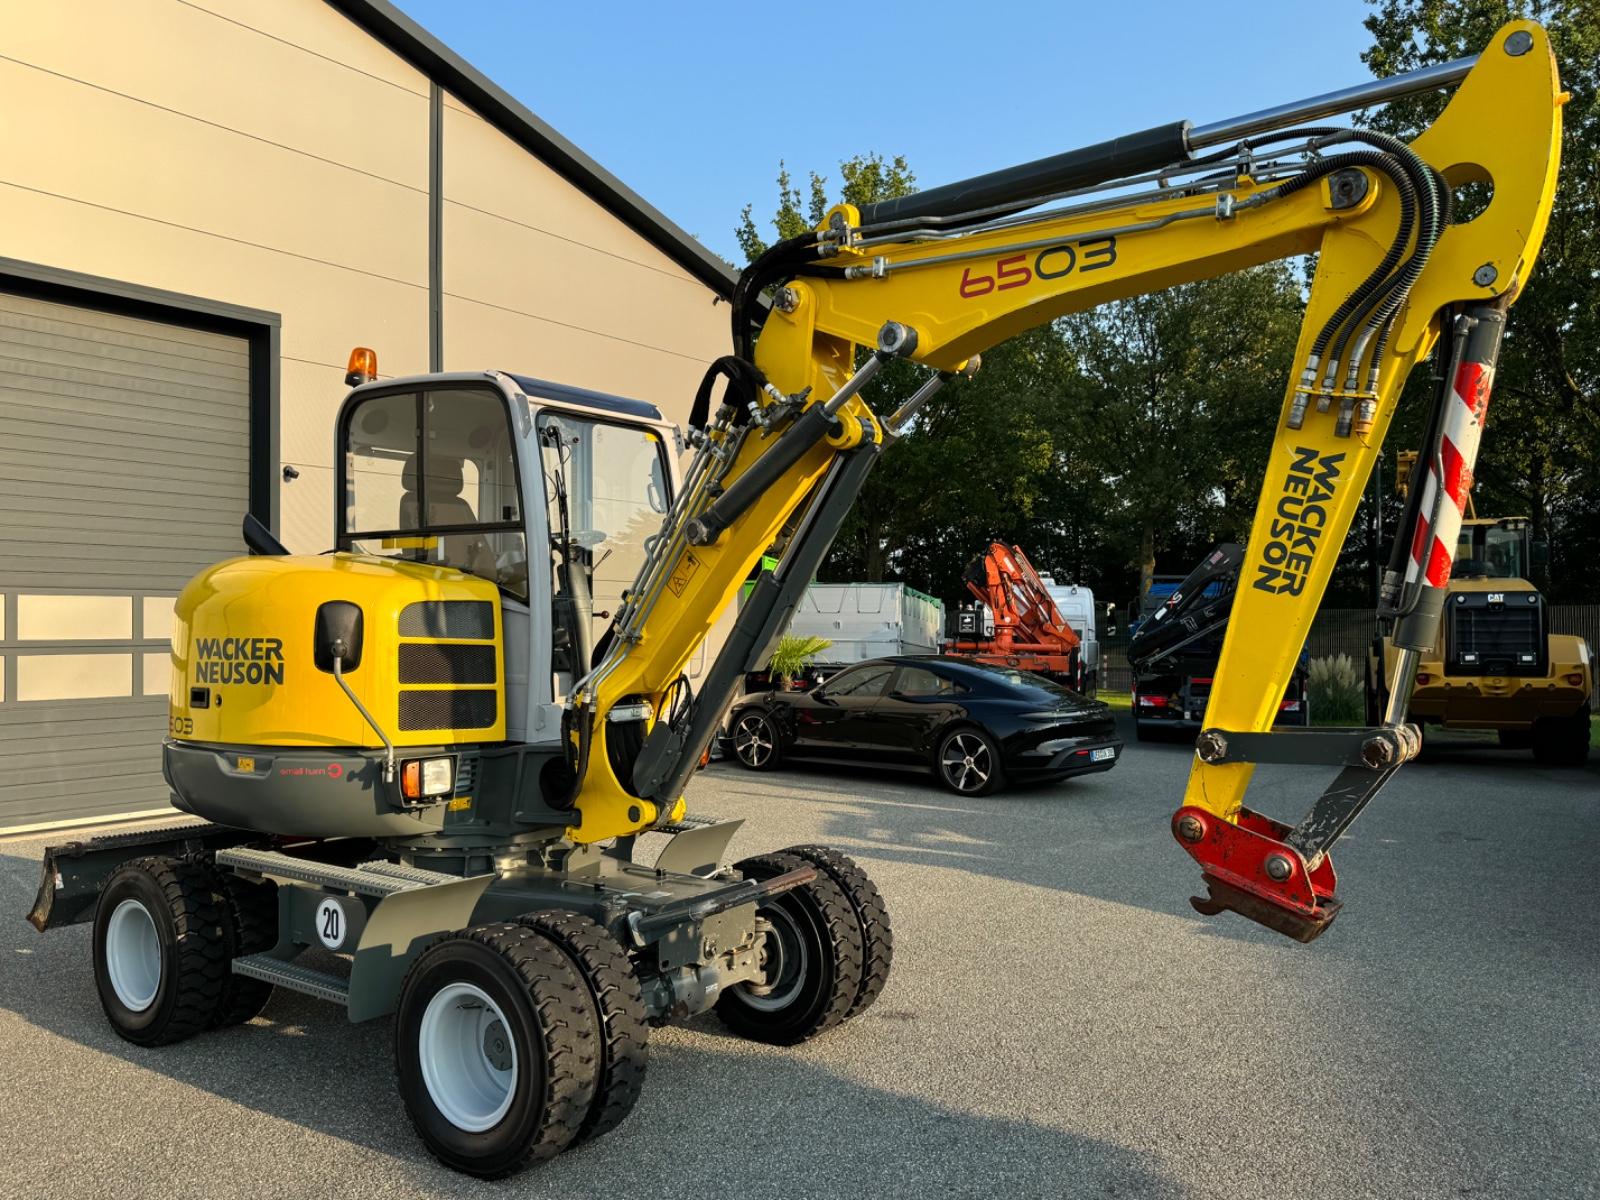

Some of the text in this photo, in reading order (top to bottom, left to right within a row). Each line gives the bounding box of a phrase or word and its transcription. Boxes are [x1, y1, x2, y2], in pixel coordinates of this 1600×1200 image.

[959, 235, 1117, 299] 6503
[1252, 446, 1320, 594] NEUSON
[1276, 452, 1347, 597] WACKER
[1487, 593, 1505, 603] CAT
[195, 637, 284, 661] WACKER
[195, 661, 284, 685] NEUSON
[323, 906, 339, 941] 20
